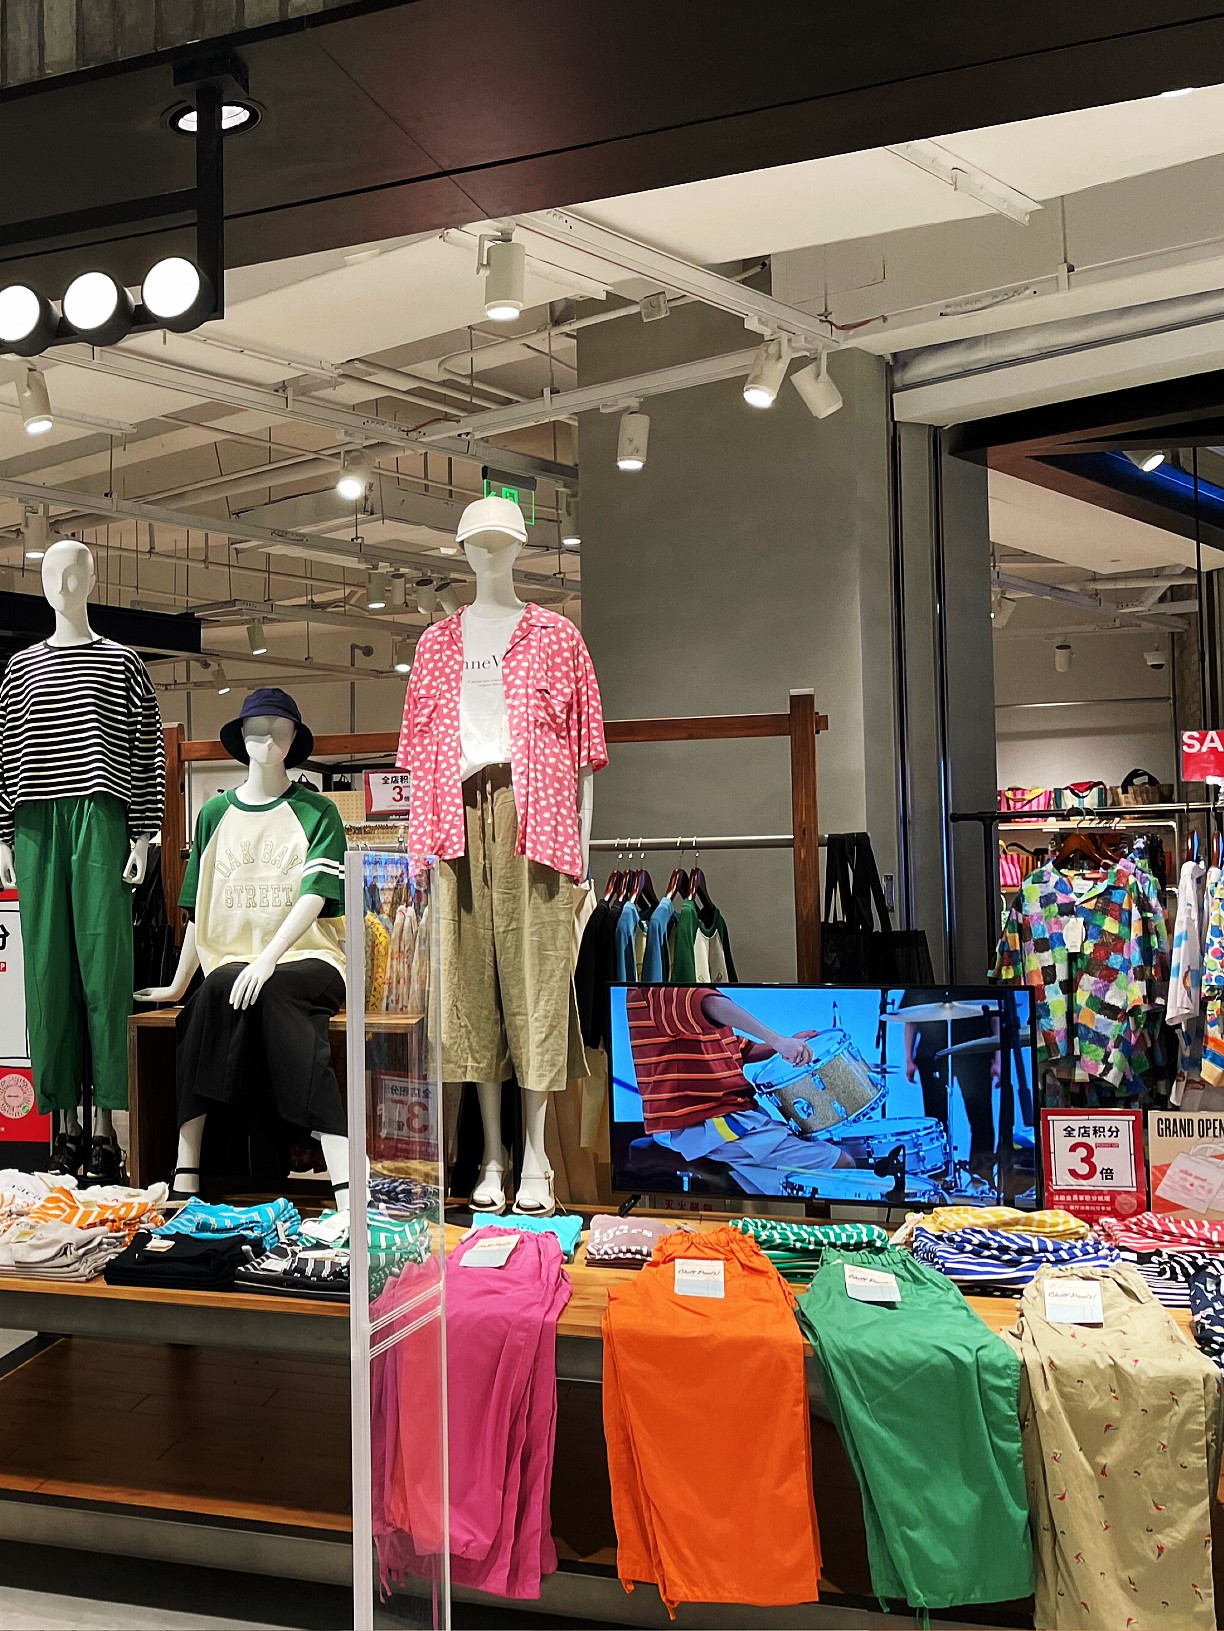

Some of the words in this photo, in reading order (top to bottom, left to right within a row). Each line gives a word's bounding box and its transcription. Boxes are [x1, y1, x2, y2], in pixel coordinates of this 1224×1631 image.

[382, 775, 410, 785] 全店积
[214, 840, 255, 878] OAK
[262, 840, 303, 875] BAY
[224, 884, 293, 908] STREET
[1063, 1125, 1120, 1138] 全店积分
[1157, 1118, 1193, 1138] GRAND
